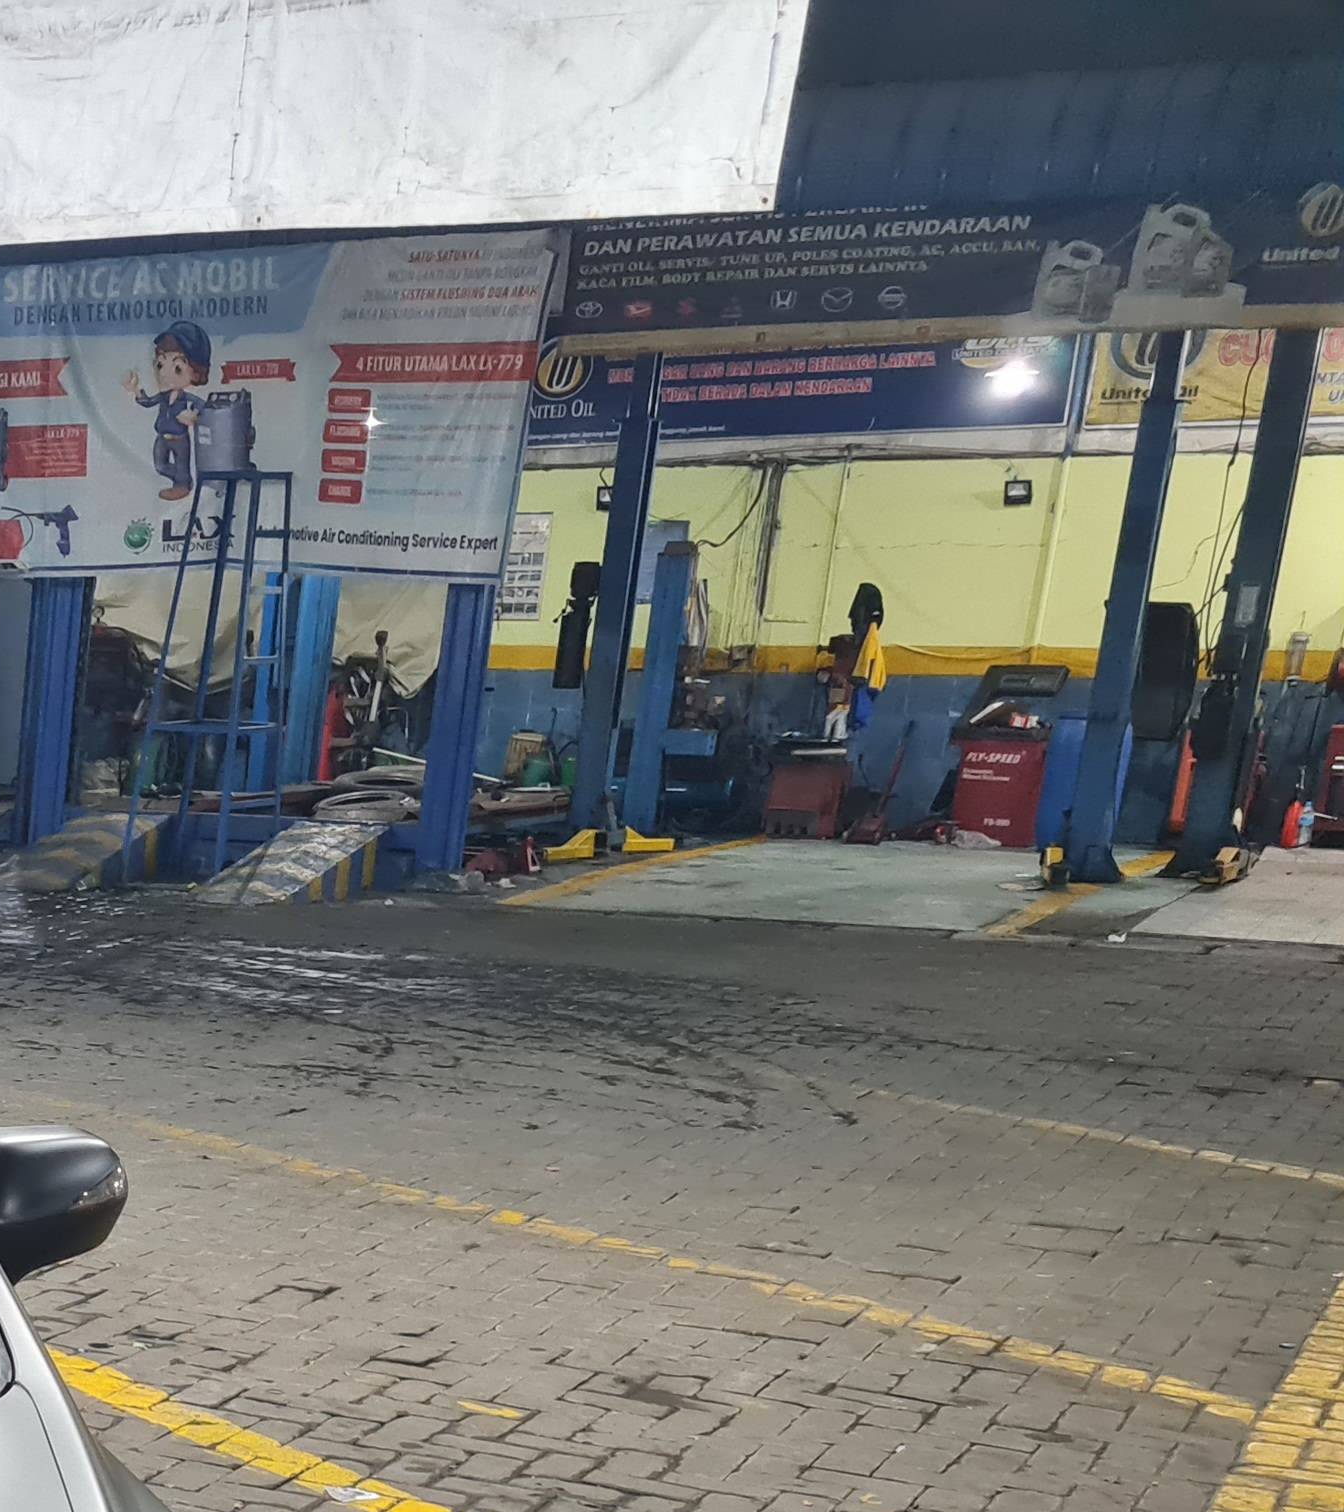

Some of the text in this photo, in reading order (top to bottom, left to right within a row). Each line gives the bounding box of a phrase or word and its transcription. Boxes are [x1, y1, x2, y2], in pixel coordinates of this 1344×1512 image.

[584, 215, 1031, 257] DAN PERAWATAN SEMUA KENDARAAN
[579, 261, 624, 275] GANTI
[721, 253, 760, 267] TUNE
[792, 248, 838, 261] POLES
[921, 244, 945, 257] AC,
[949, 241, 998, 255] ACCU,
[1262, 245, 1340, 263] United
[3, 255, 280, 302] SERVICE AC MOBIL
[576, 276, 617, 290] KACA
[662, 272, 700, 285] BODY
[706, 268, 760, 283] REPAIR
[764, 265, 797, 280] DAN
[800, 261, 854, 277] SERVIS
[858, 260, 928, 274] LAINNYA
[13, 295, 269, 327] DENGAN TEKNOLOGI MODERN
[355, 357, 363, 371] 4
[366, 356, 401, 372] FITUR
[404, 355, 449, 372] UTAMA
[451, 354, 478, 371] LAX
[807, 353, 878, 373] BERHARGA
[10, 372, 42, 388] KAMI
[570, 399, 597, 419] OIL
[320, 526, 336, 543] Air
[337, 528, 410, 552] Conditioning
[411, 532, 458, 550] Service
[459, 534, 498, 555] Expert
[965, 751, 1021, 764] FLY-SPEED
